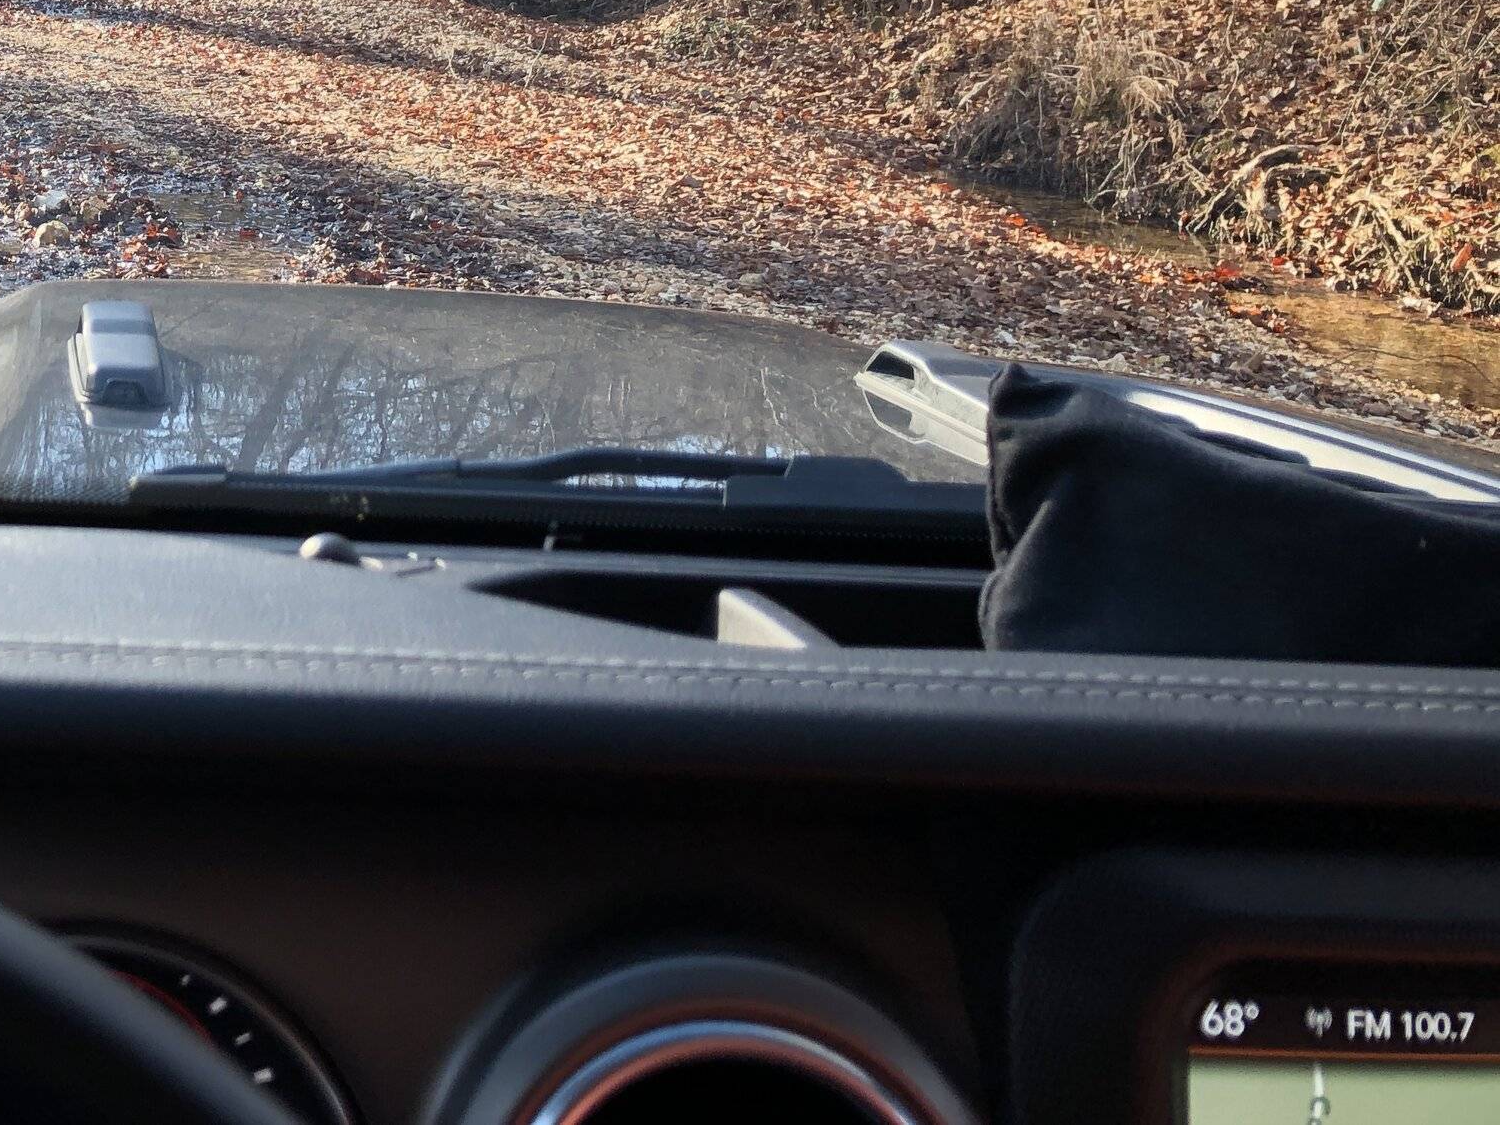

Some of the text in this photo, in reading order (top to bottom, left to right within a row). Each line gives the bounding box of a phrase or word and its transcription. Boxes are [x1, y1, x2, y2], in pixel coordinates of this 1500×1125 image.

[1201, 999, 1260, 1037] 68°
[1347, 1009, 1475, 1042] FM 100.7
